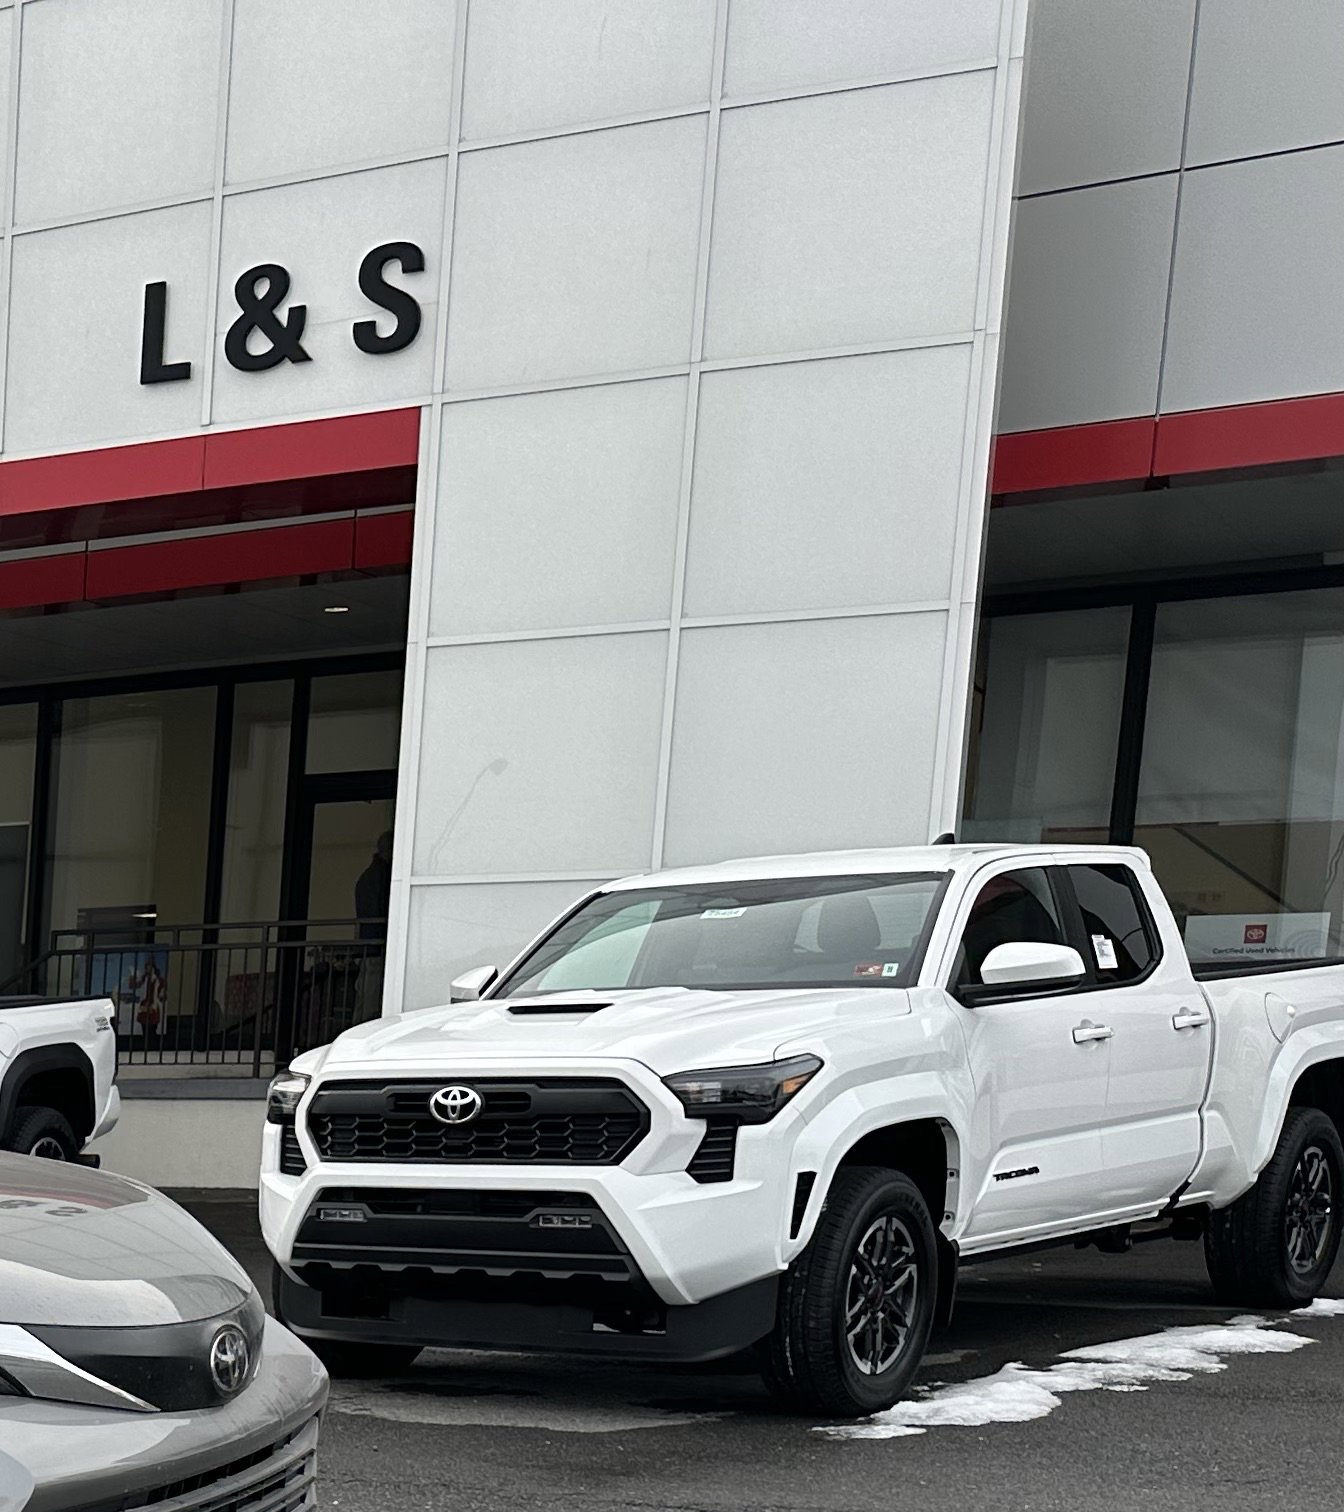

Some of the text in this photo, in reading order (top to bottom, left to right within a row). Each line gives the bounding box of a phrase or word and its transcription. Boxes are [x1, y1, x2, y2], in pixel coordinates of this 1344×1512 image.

[140, 241, 425, 386] L & S
[992, 1166, 1040, 1182] TACOMA
